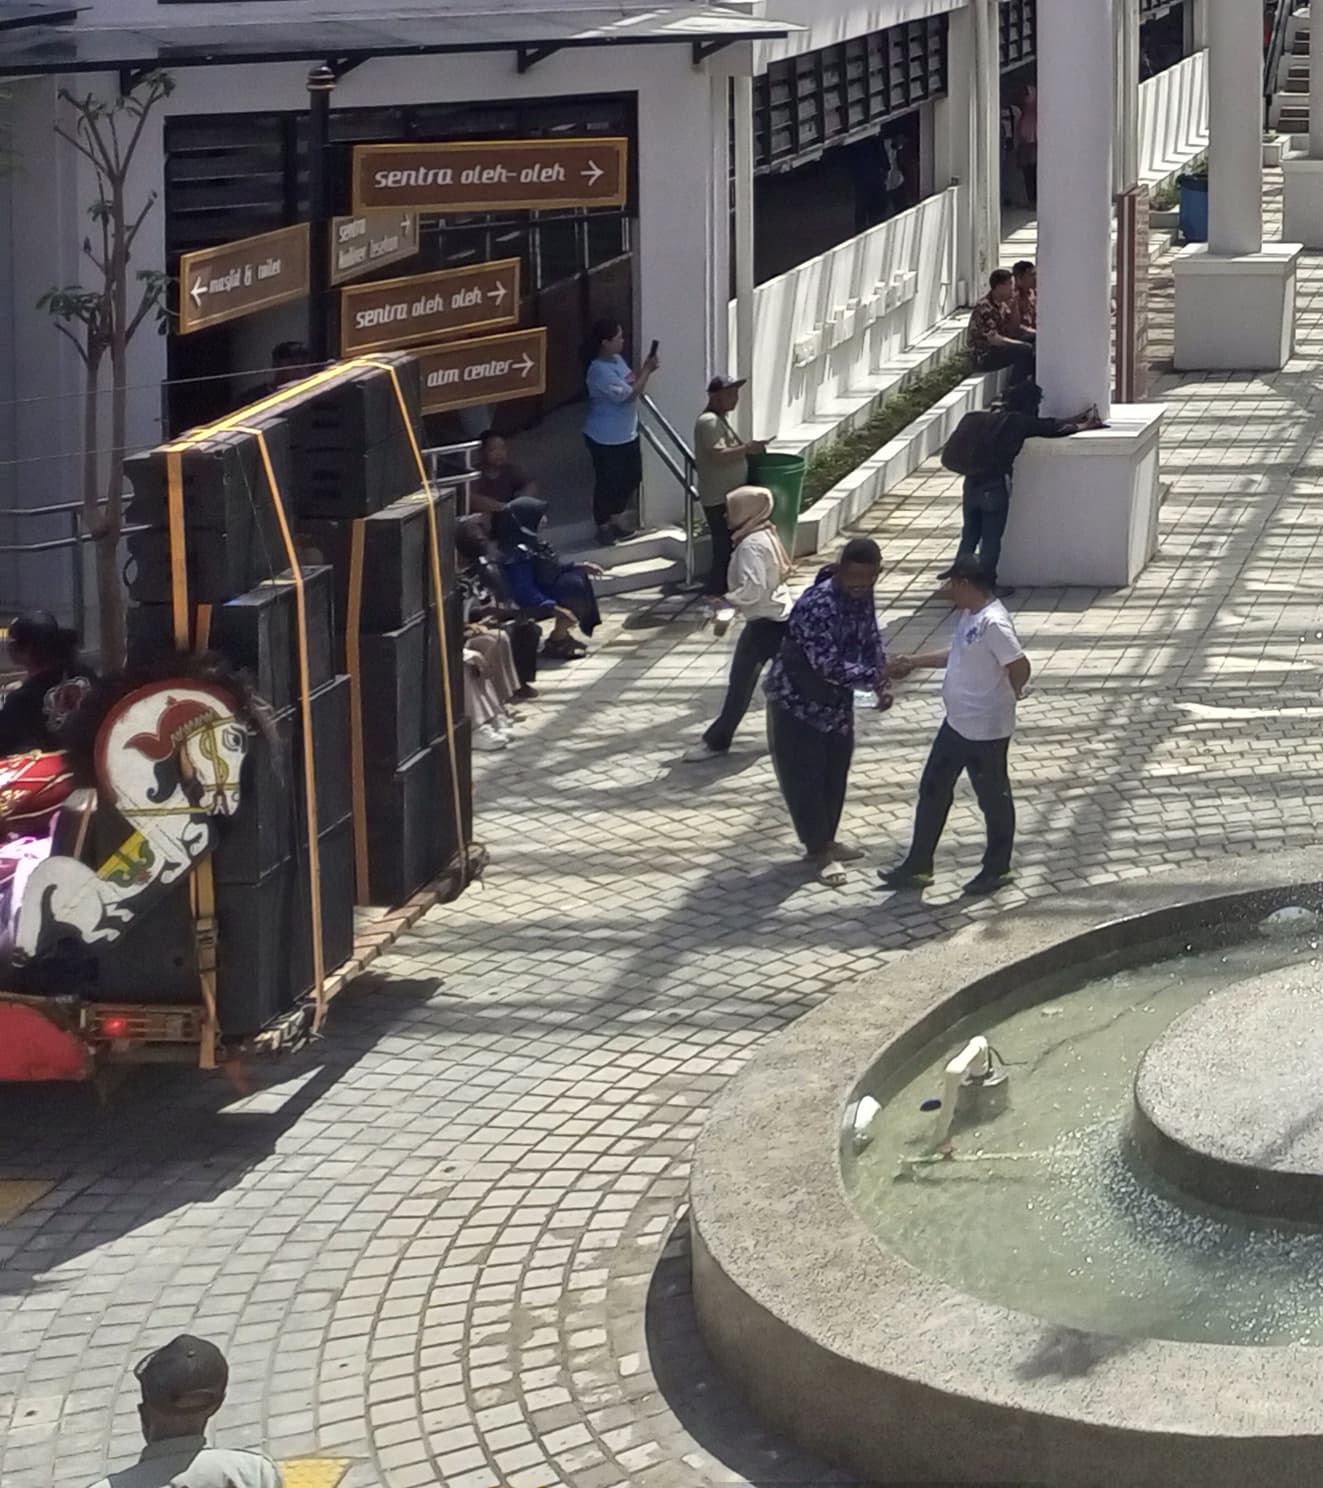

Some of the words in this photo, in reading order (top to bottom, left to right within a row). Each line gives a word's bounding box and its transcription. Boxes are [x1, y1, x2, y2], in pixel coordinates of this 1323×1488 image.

[374, 165, 454, 189] sentra
[460, 162, 566, 185] oleh-oleh
[355, 303, 408, 329] sentra
[411, 293, 444, 318] oleh
[451, 285, 483, 309] oleh
[426, 367, 460, 388] atm
[463, 359, 513, 382] center
